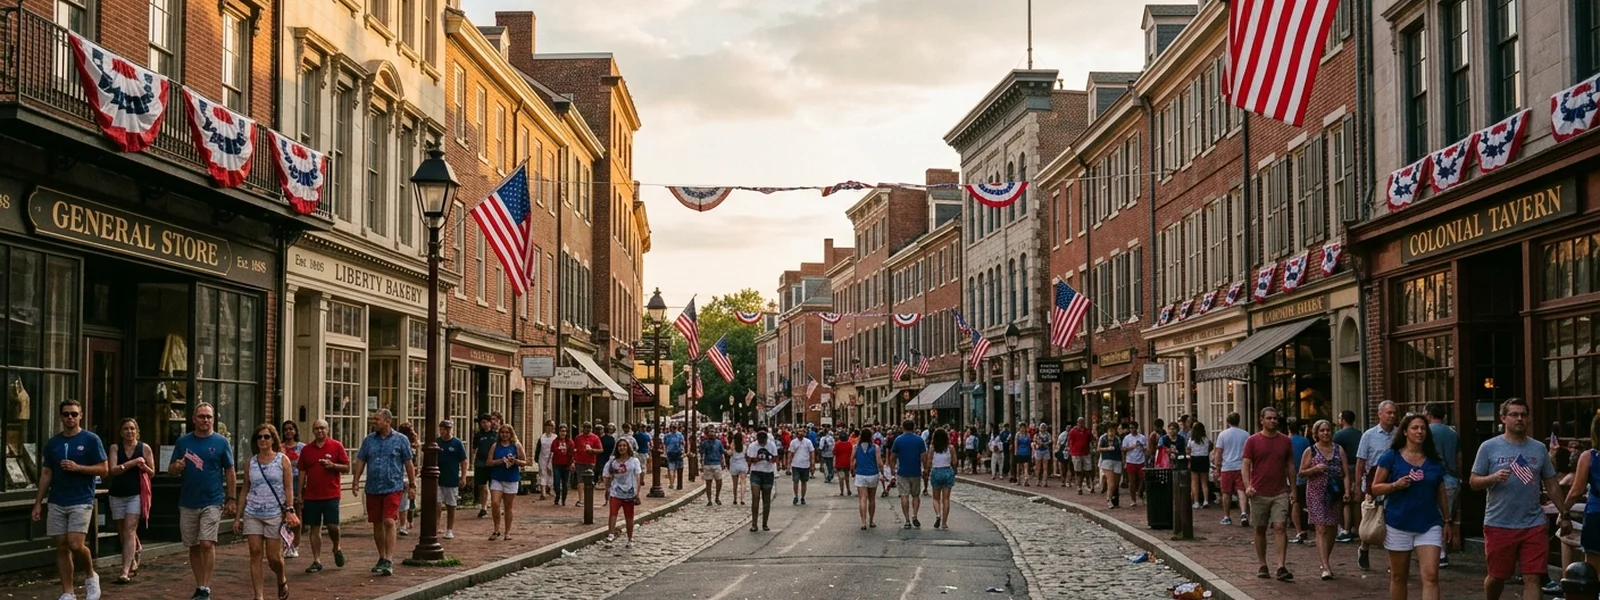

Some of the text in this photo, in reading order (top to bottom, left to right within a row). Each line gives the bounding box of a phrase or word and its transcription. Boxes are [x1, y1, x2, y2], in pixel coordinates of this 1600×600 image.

[52, 200, 219, 267] GENERAL STORE
[1409, 185, 1563, 257] COLONIAL TAVERN
[335, 263, 383, 293] LIBERTY
